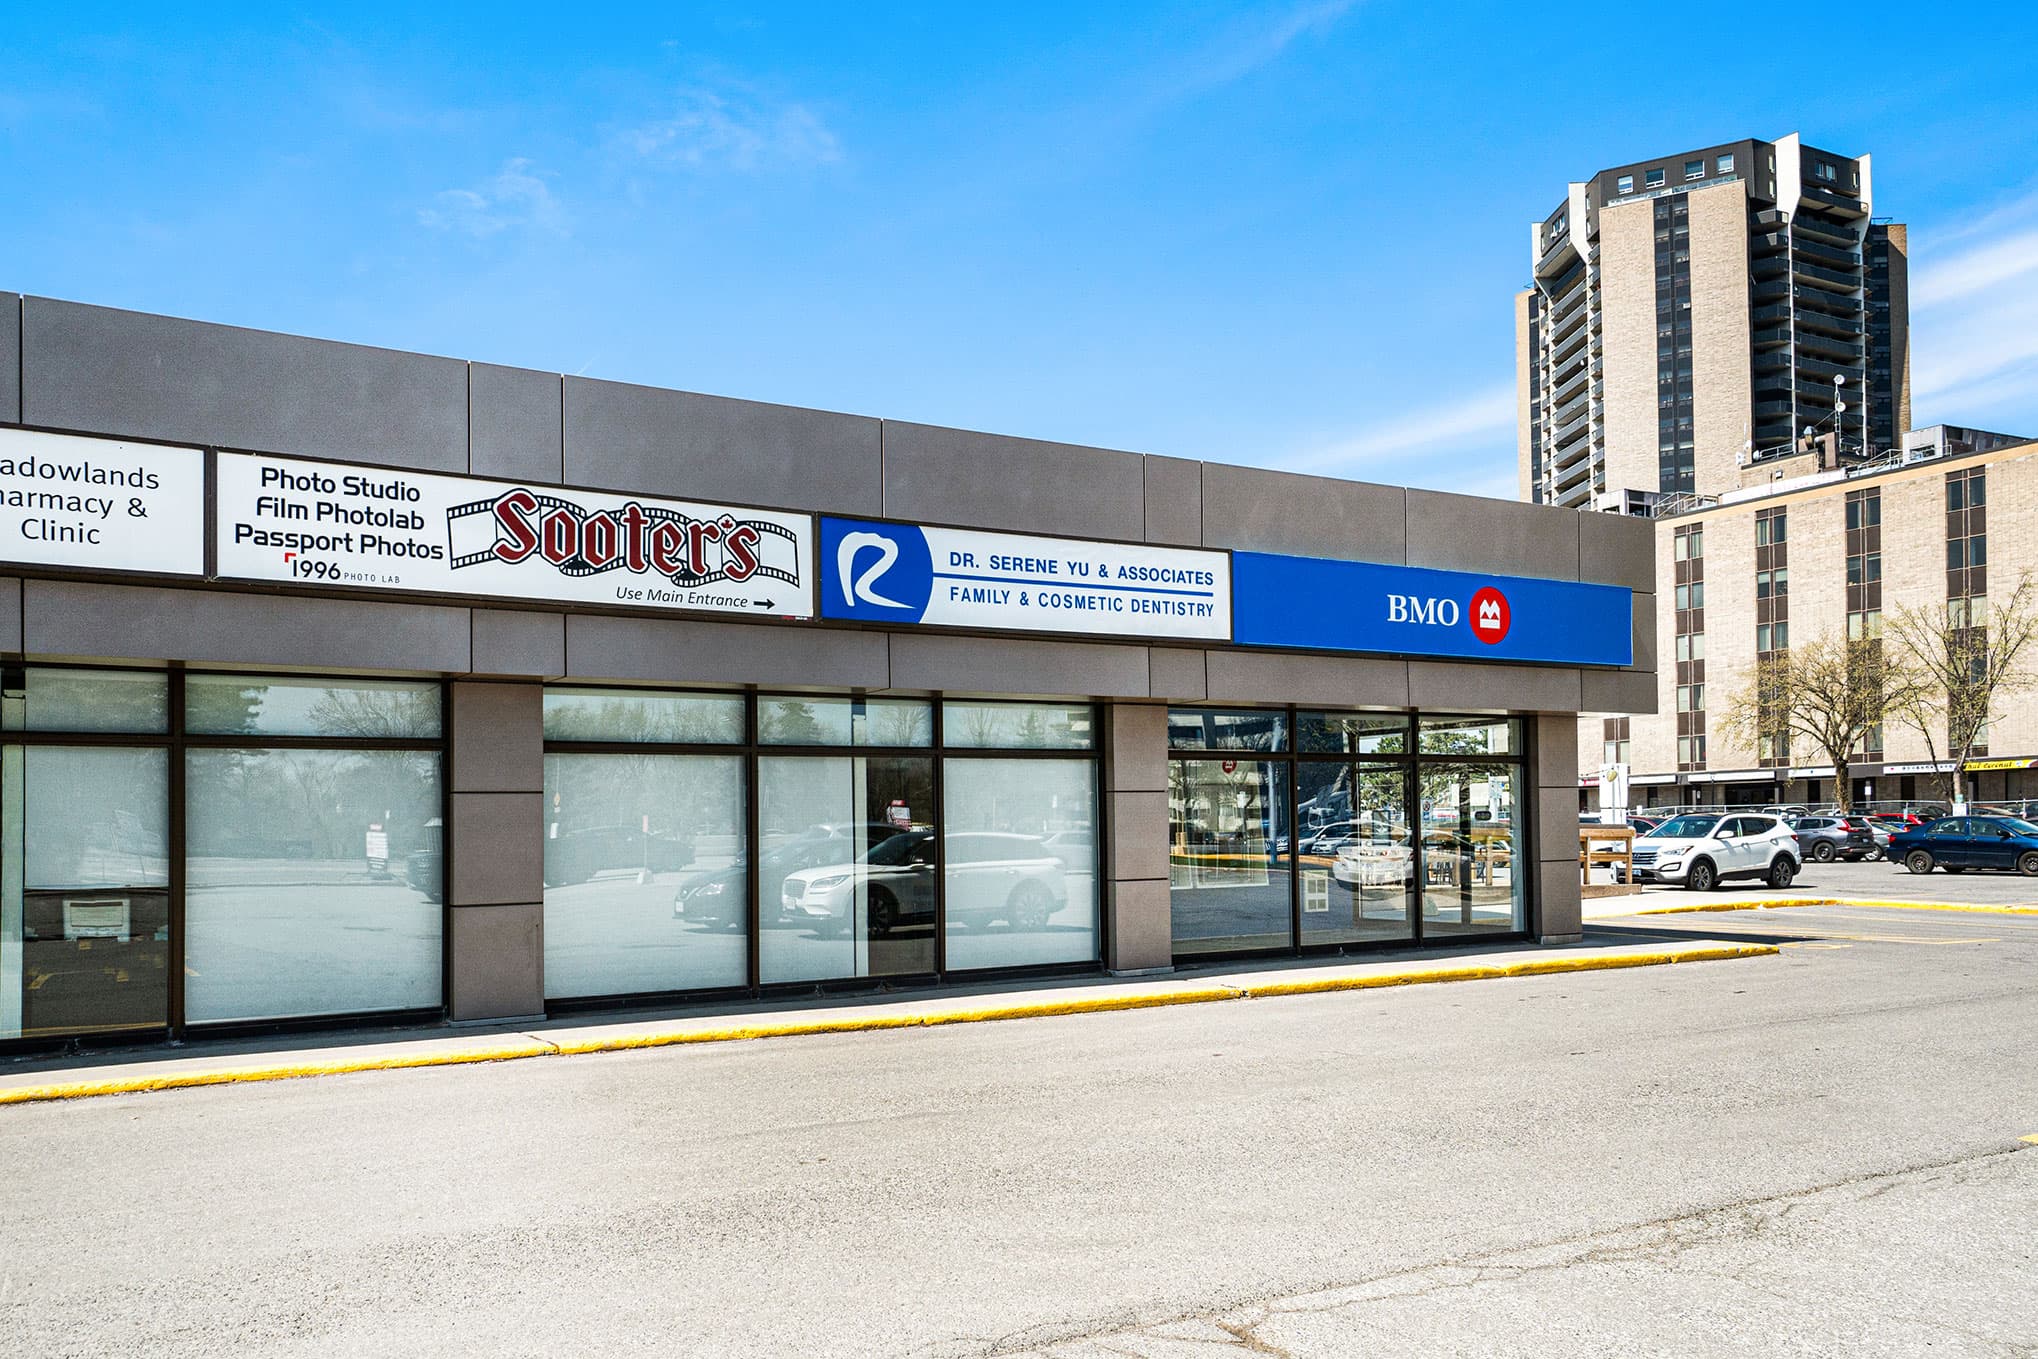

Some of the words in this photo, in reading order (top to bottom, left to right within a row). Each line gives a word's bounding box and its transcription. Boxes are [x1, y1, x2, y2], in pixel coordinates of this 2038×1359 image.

[261, 466, 337, 494] Photo
[342, 475, 421, 503] Studio
[0, 489, 114, 520] armacy
[127, 497, 148, 518] &
[256, 496, 309, 521] Film
[316, 501, 425, 531] Photolab
[21, 518, 101, 545] Clinic
[235, 522, 354, 555] Passport
[360, 533, 444, 561] Photos
[292, 559, 341, 581] 1996
[343, 571, 376, 583] PHOTO
[381, 574, 401, 584] LAB
[949, 551, 980, 569] DR.
[989, 554, 1058, 575] SERENE
[1066, 560, 1089, 577] YU
[1098, 563, 1109, 579] &
[1117, 565, 1214, 586] ASSOCIATES
[616, 586, 643, 601] Use
[646, 588, 684, 603] Main
[687, 591, 748, 608] Entrance
[950, 586, 1011, 605] FAMILY
[1019, 591, 1030, 607] &
[1038, 592, 1123, 612] COSMETIC
[1131, 598, 1214, 617] DENTISTRY
[1387, 594, 1459, 626] BMO
